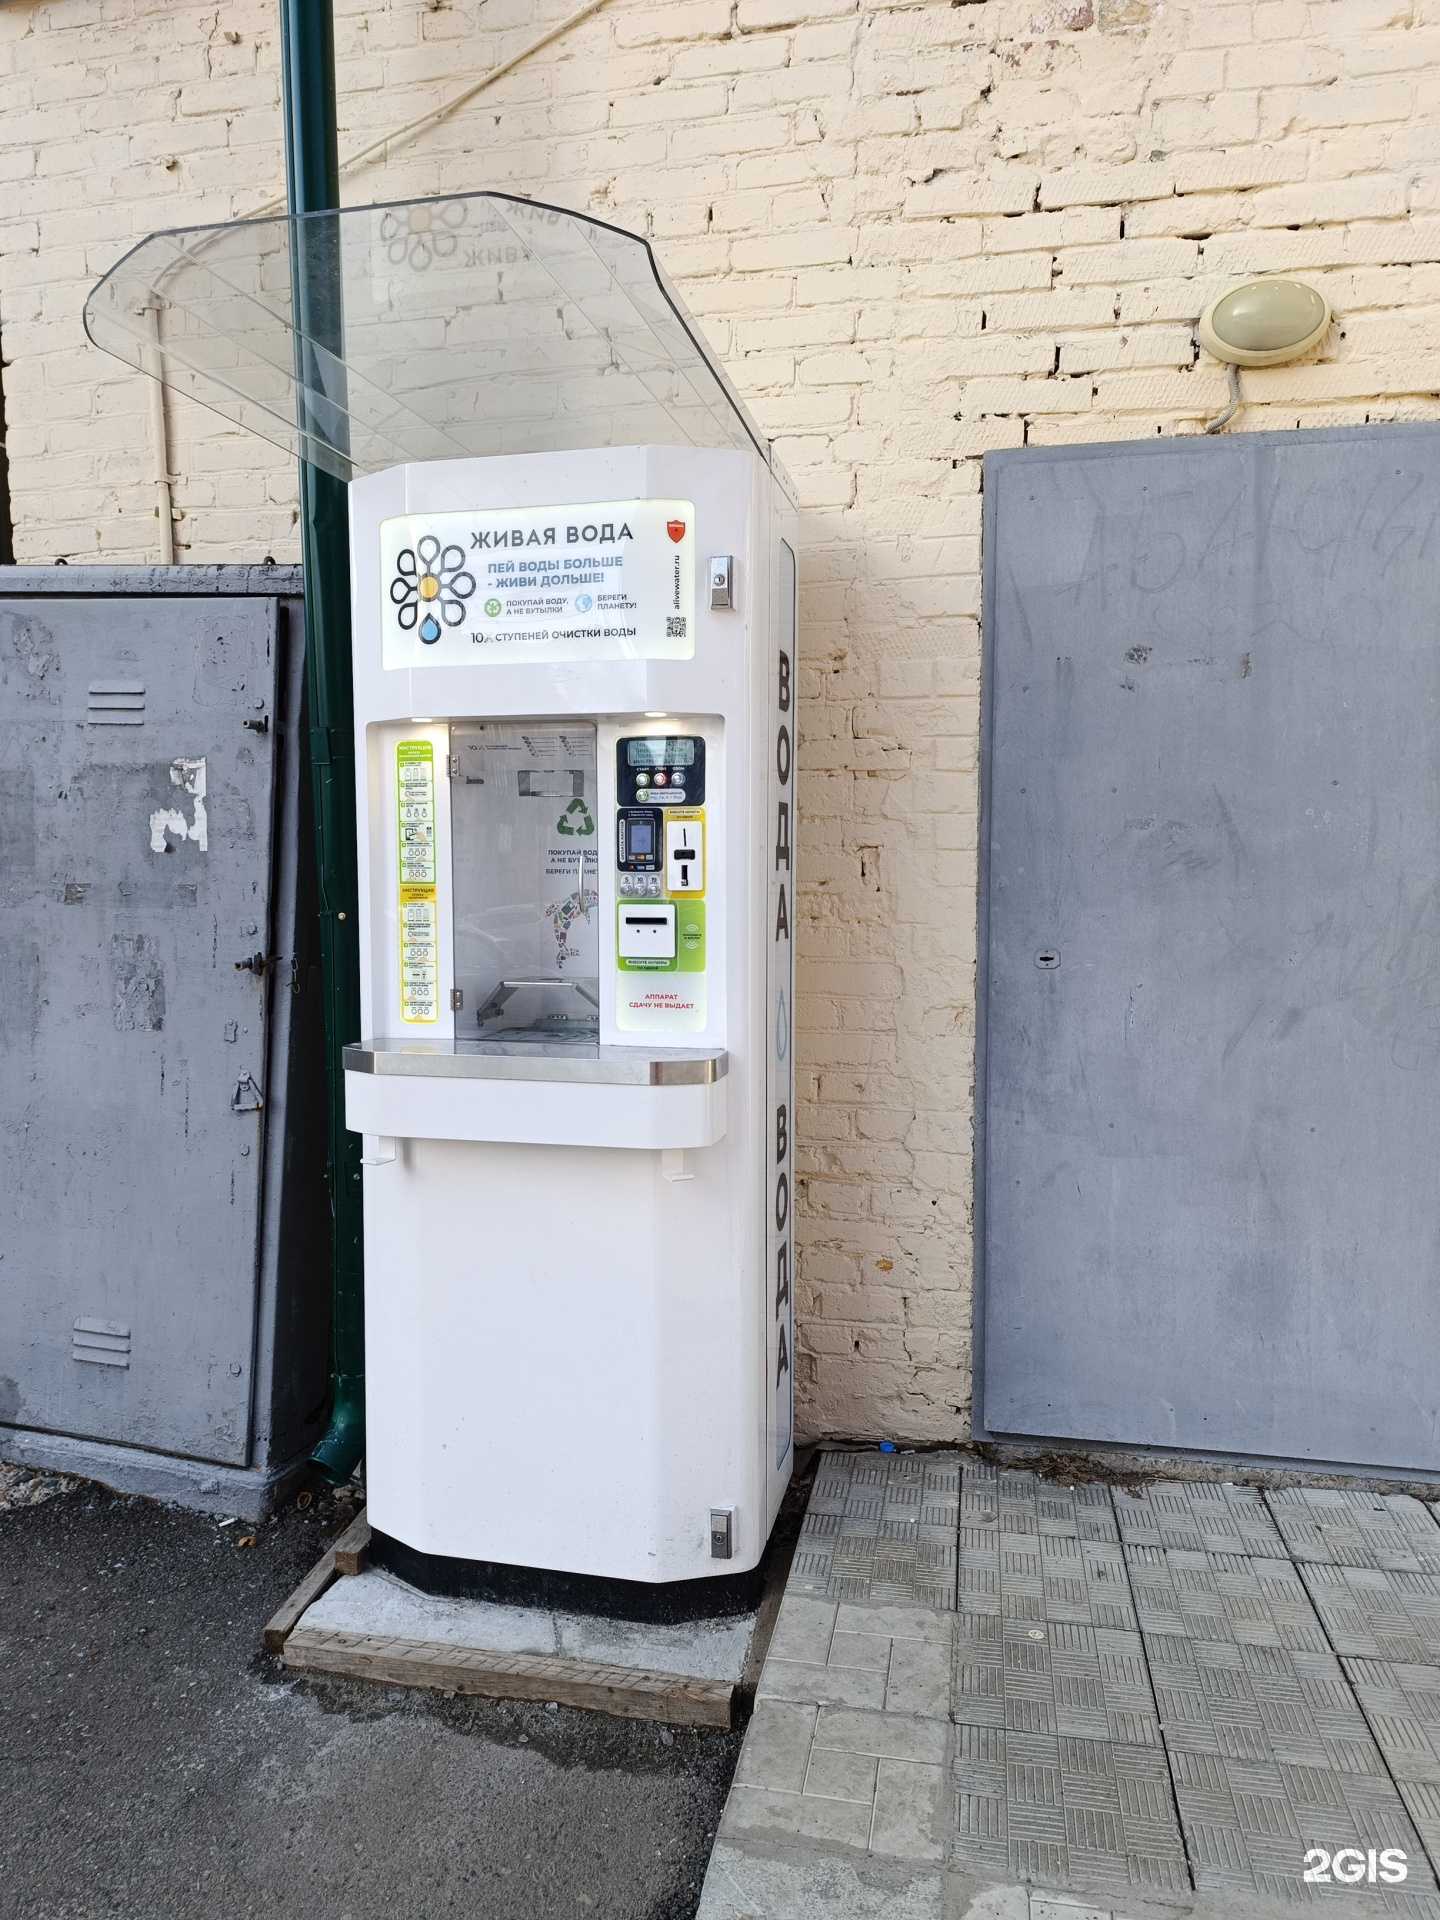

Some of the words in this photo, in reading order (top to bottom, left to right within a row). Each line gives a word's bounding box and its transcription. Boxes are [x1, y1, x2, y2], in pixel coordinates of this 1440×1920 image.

[470, 527, 556, 549] ЖИВАЯ
[566, 522, 634, 544] ВОДА
[488, 561, 515, 574] ПЕЙ
[518, 559, 560, 573] ВОДЫ
[563, 556, 624, 569] БОЛЬШЕ
[496, 575, 537, 588] ЖИВИ
[540, 572, 605, 588] ДОЛЬШЕ!
[506, 598, 544, 607] ПОКУПАЙ
[597, 594, 627, 602] БЕРЕГИ
[525, 606, 563, 614] БУТЫЛКИ
[597, 602, 637, 610] ПЛАНЕТУ!
[495, 629, 549, 642] СТУПЕНЕЙ
[551, 628, 601, 640] ОЧИСТКИ
[603, 627, 637, 638] ВОДЫ
[775, 649, 791, 942] ВОДА
[628, 1001, 652, 1009] СДАЧУ
[664, 1002, 694, 1010] ВЫДАЕТ
[775, 1103, 790, 1391] ВОДА
